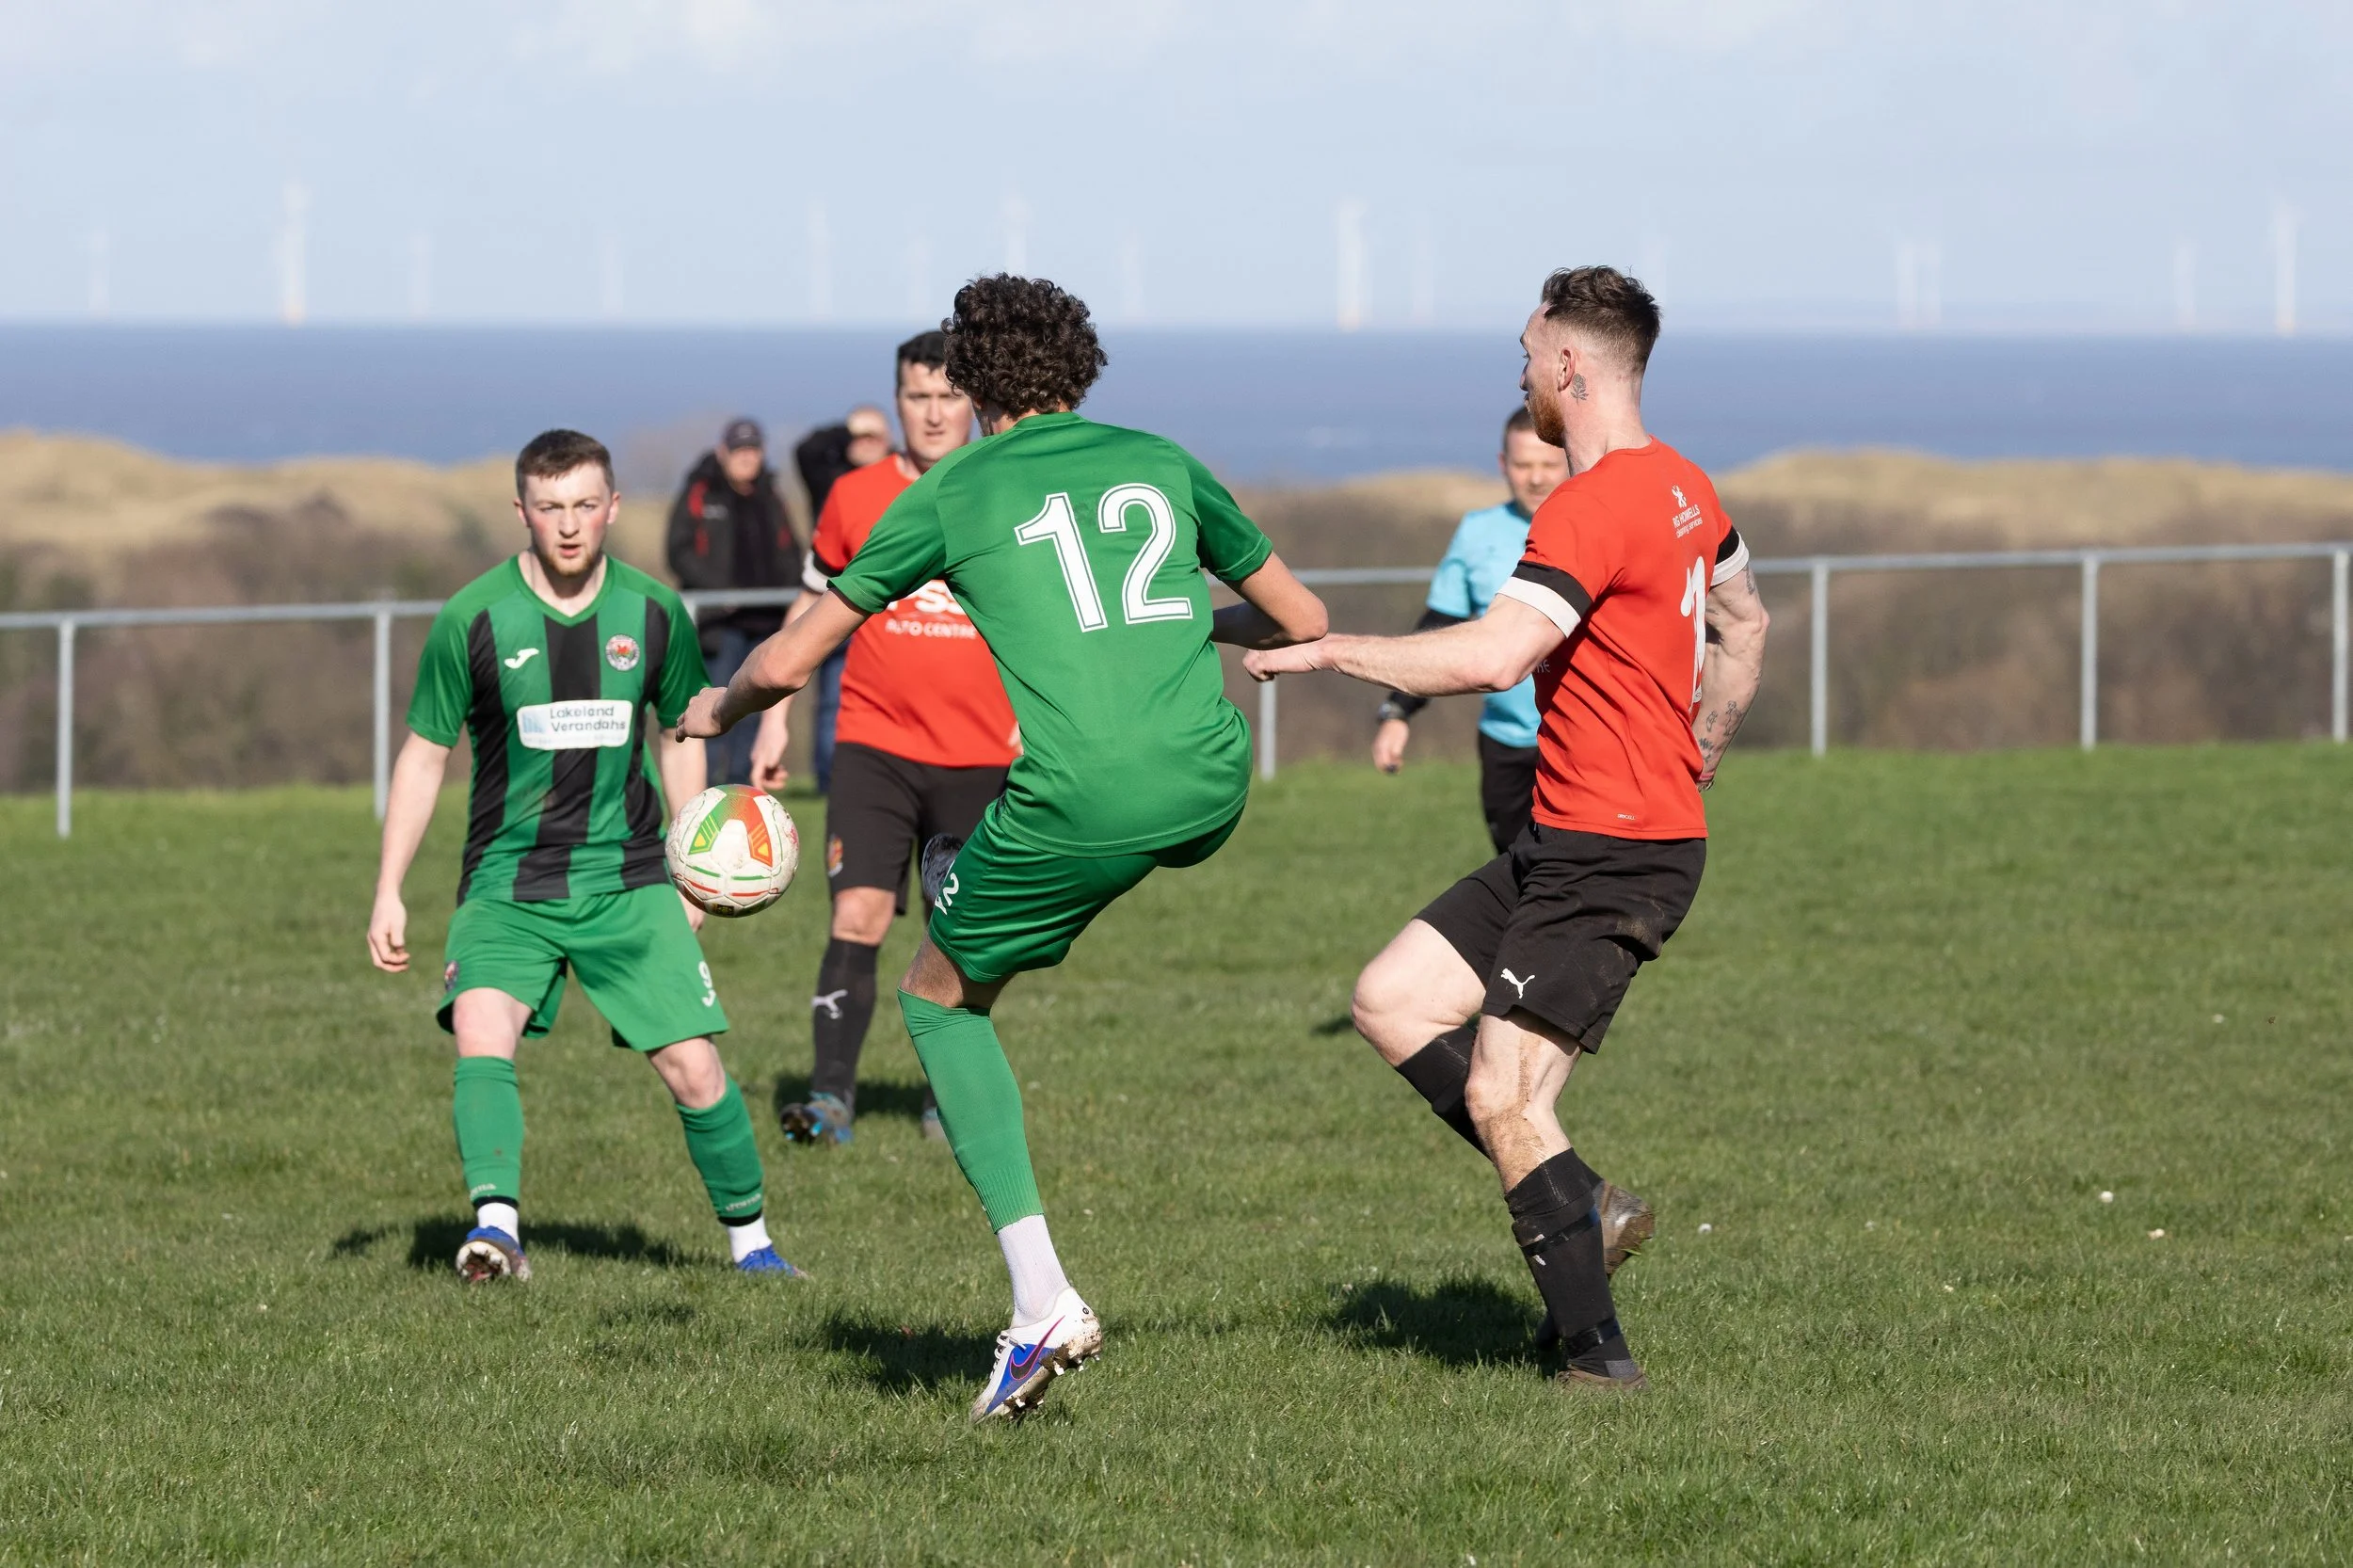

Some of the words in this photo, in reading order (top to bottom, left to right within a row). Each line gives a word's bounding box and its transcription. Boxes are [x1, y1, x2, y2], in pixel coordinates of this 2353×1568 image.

[1014, 482, 1193, 633] 12
[550, 706, 615, 720] Lakeland
[551, 719, 626, 732] Verandahs
